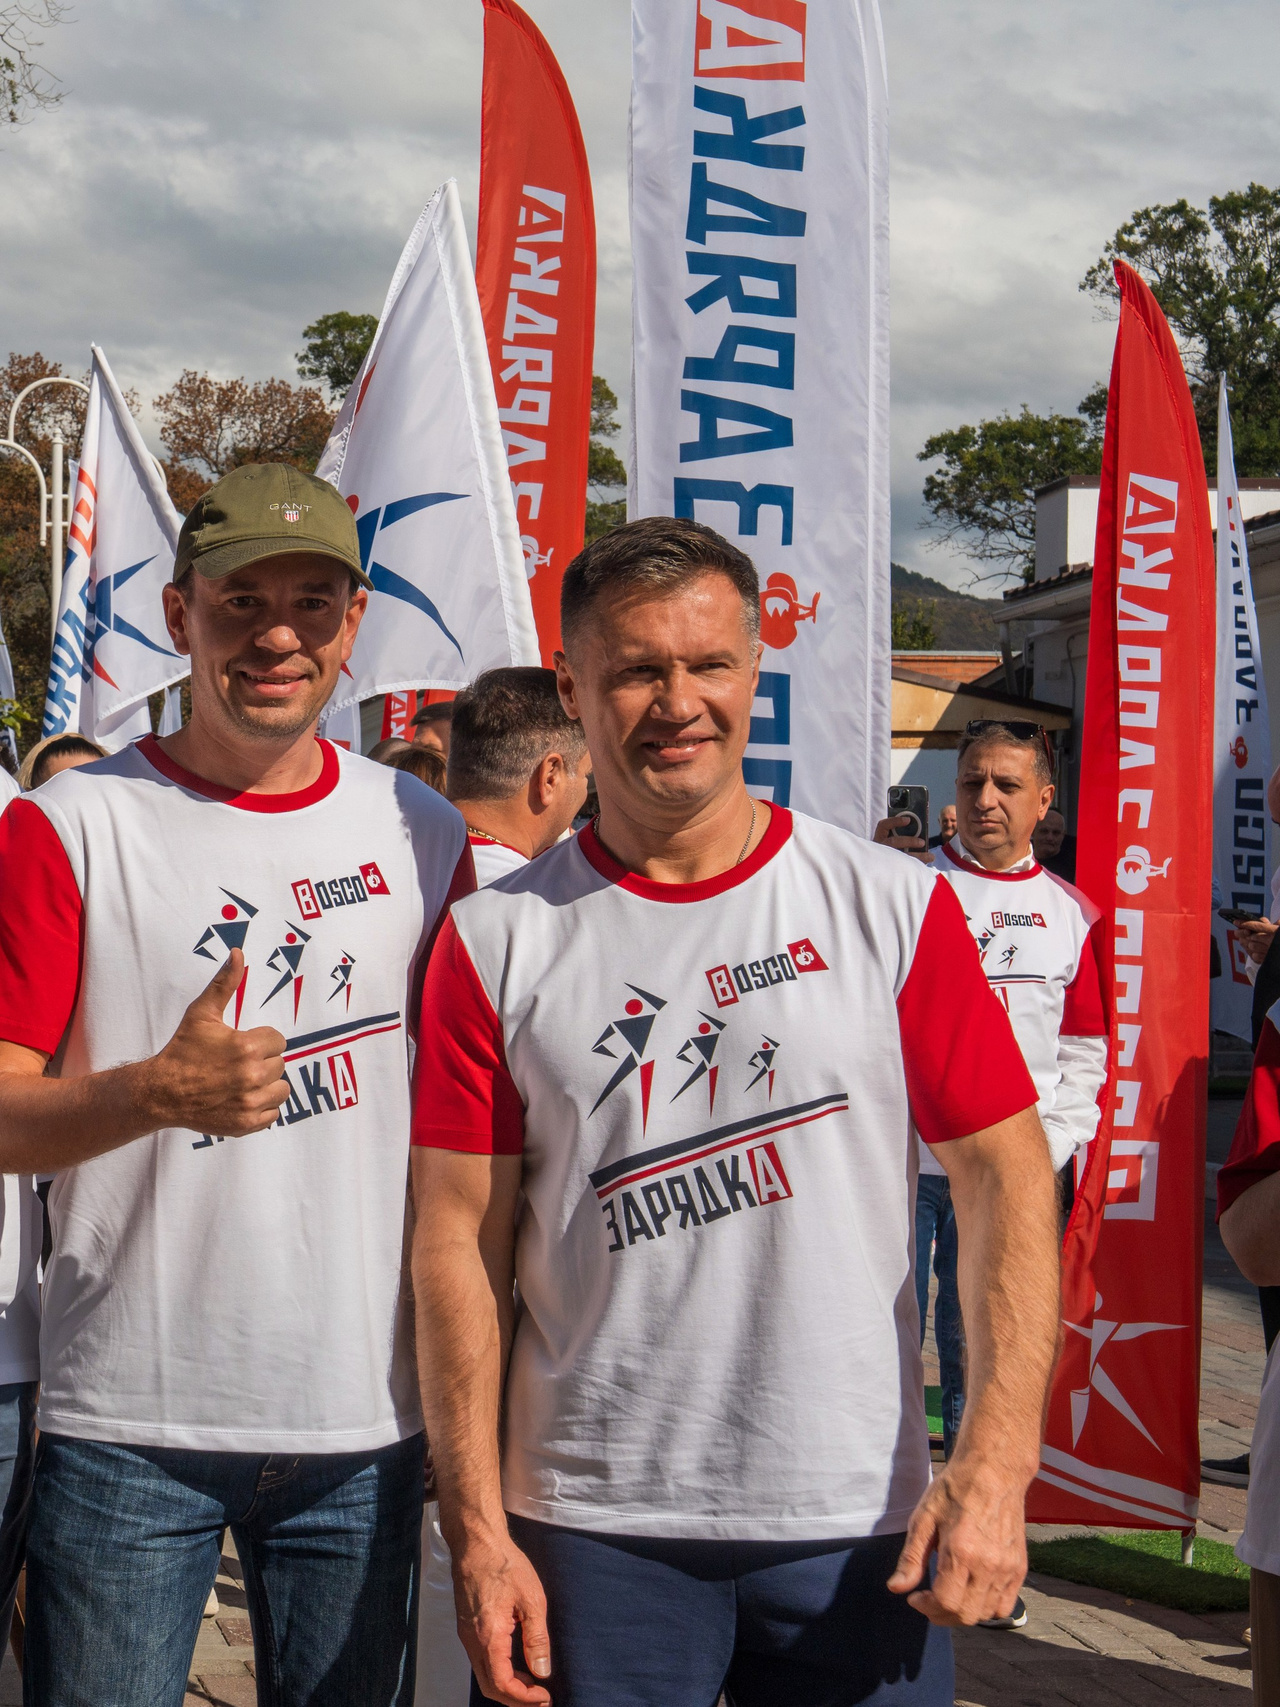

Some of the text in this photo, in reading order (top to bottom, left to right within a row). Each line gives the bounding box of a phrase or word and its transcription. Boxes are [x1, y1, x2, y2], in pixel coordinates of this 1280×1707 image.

[269, 502, 313, 512] GANT
[291, 875, 368, 921] BOSCO
[705, 953, 797, 1008] BOSCO
[601, 1141, 794, 1253] ЗАРЯДКА
